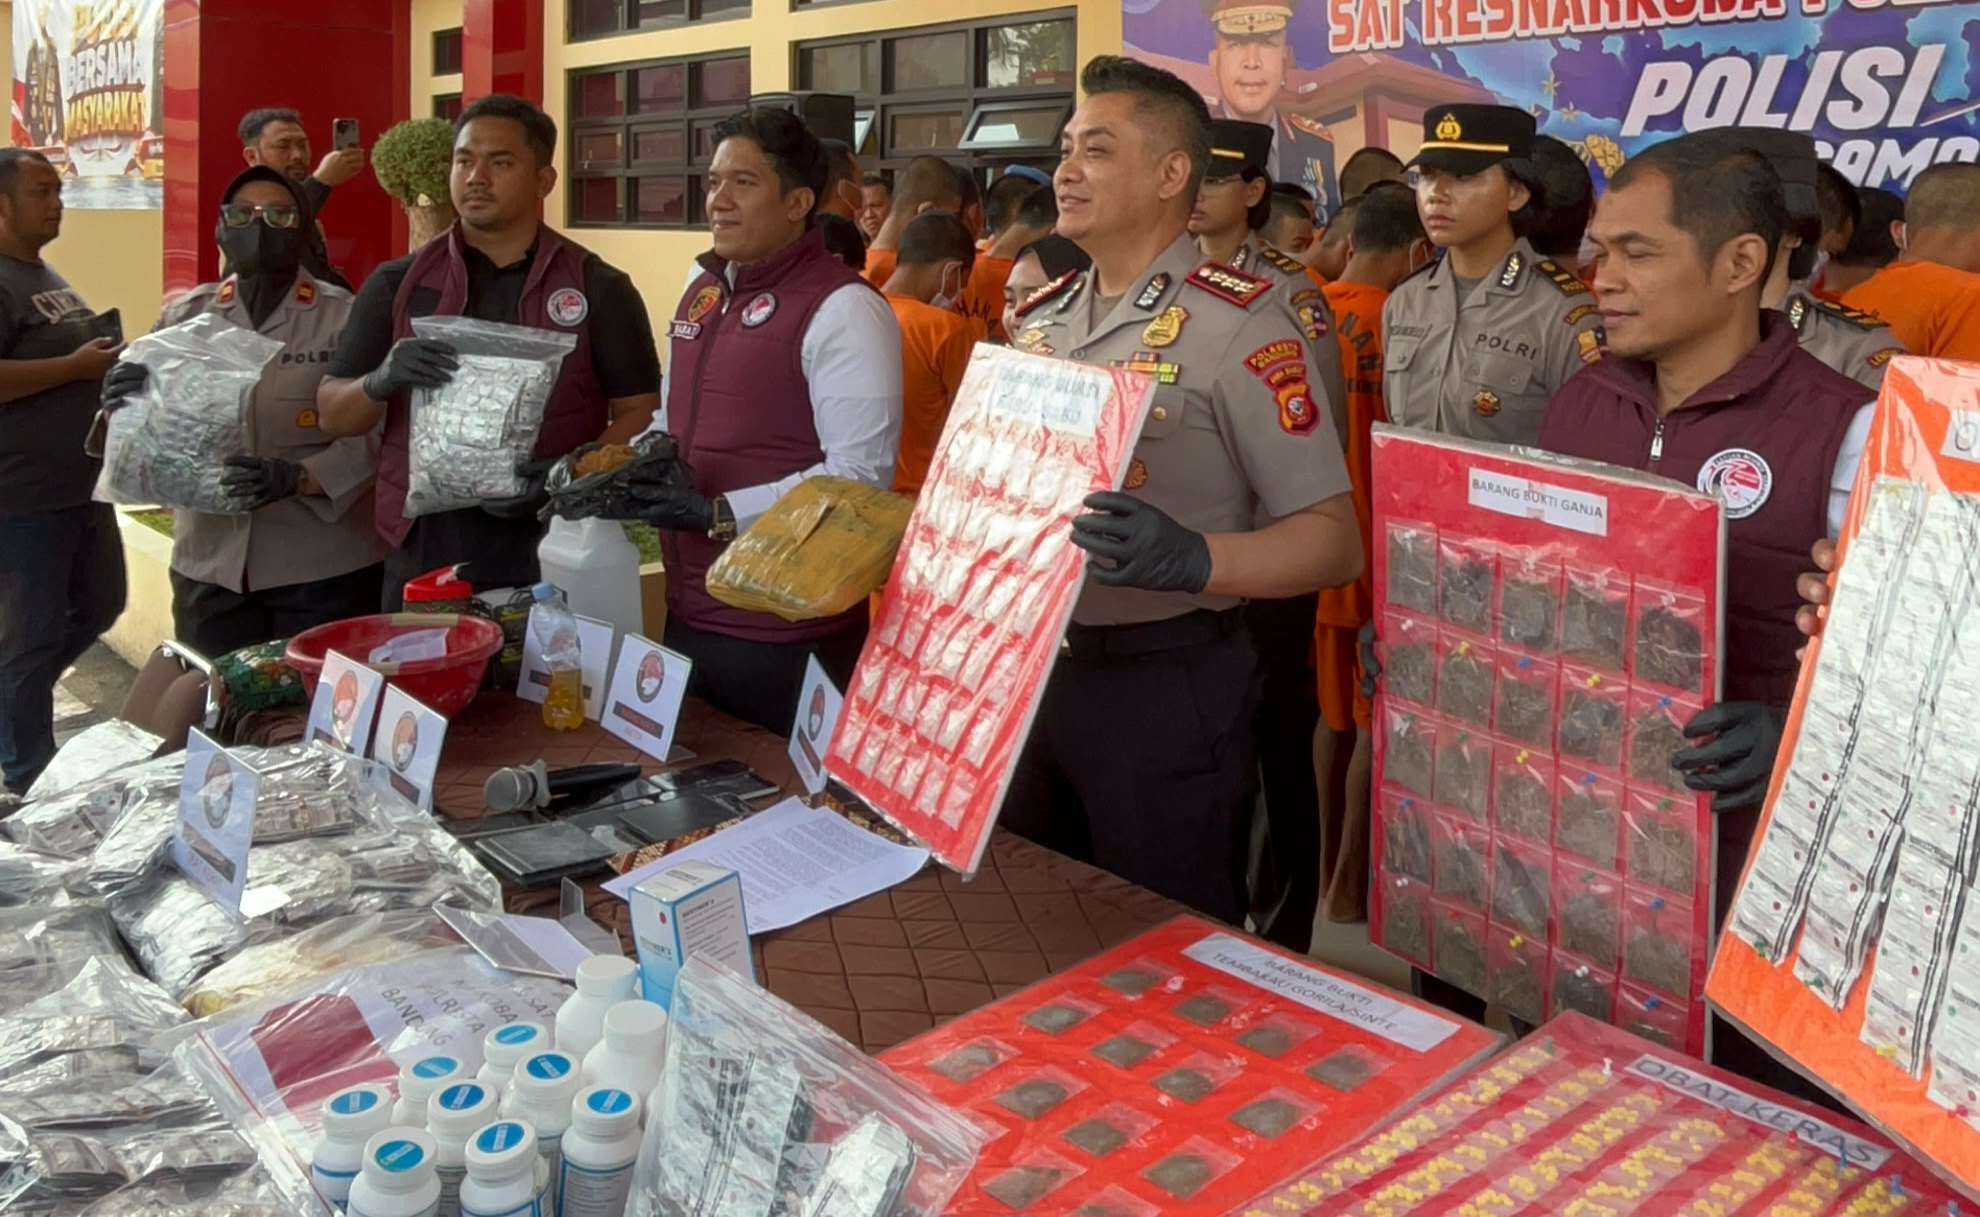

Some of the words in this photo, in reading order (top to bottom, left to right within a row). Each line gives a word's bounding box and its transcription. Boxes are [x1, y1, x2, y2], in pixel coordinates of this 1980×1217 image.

[1328, 0, 1404, 52] SAT
[68, 40, 146, 93] BERSAMA
[1620, 43, 1947, 137] POLISI
[1475, 332, 1537, 360] POLRI
[1472, 478, 1520, 500] BARANG
[1523, 490, 1558, 508] BUKTI
[1561, 500, 1603, 519] GANJA
[1211, 951, 1292, 988] TEMBAKAU
[1264, 959, 1326, 987] BARANG
[1326, 984, 1373, 1006] BUKTI
[1636, 1057, 1741, 1108] OBAT
[1743, 1101, 1876, 1164] KERAS
